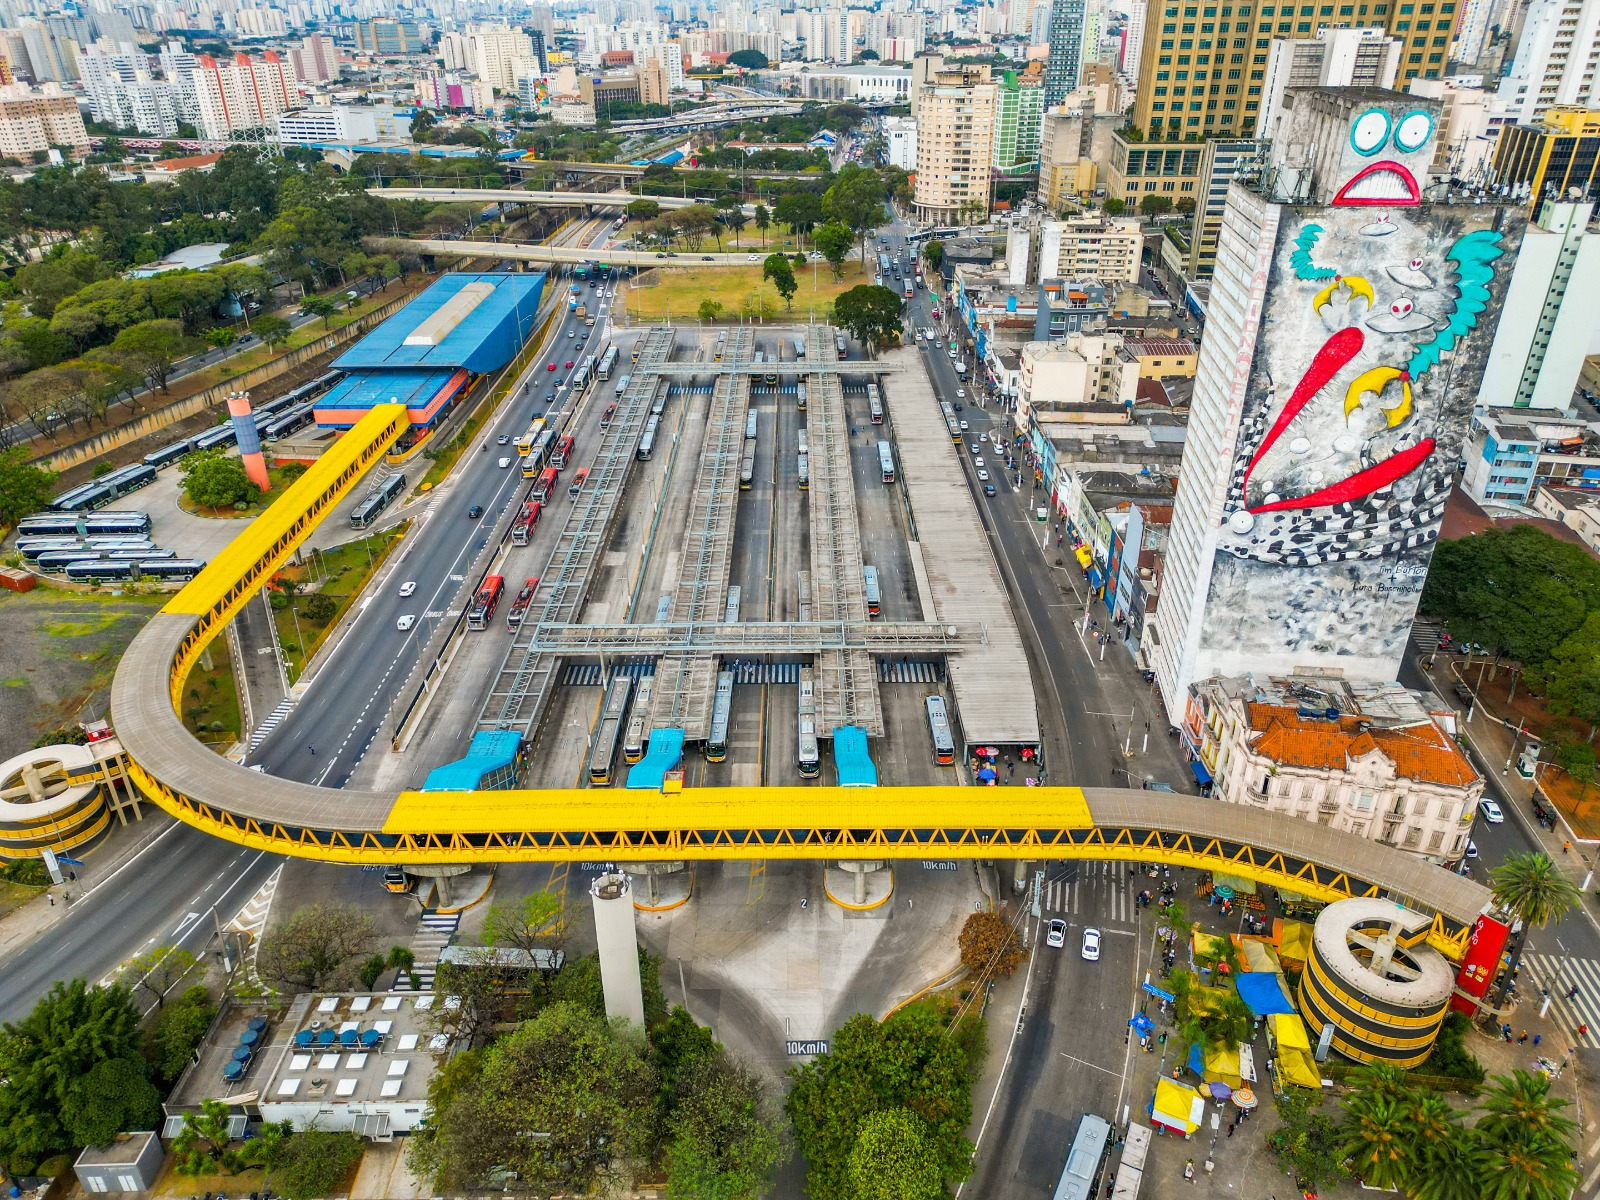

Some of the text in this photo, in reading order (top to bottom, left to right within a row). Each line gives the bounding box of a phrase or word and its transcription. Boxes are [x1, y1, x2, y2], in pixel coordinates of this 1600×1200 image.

[1379, 565, 1427, 575] Tim Burton
[922, 860, 957, 871] 10km/h
[801, 898, 807, 909] 2
[787, 1042, 827, 1054] 10km/h
